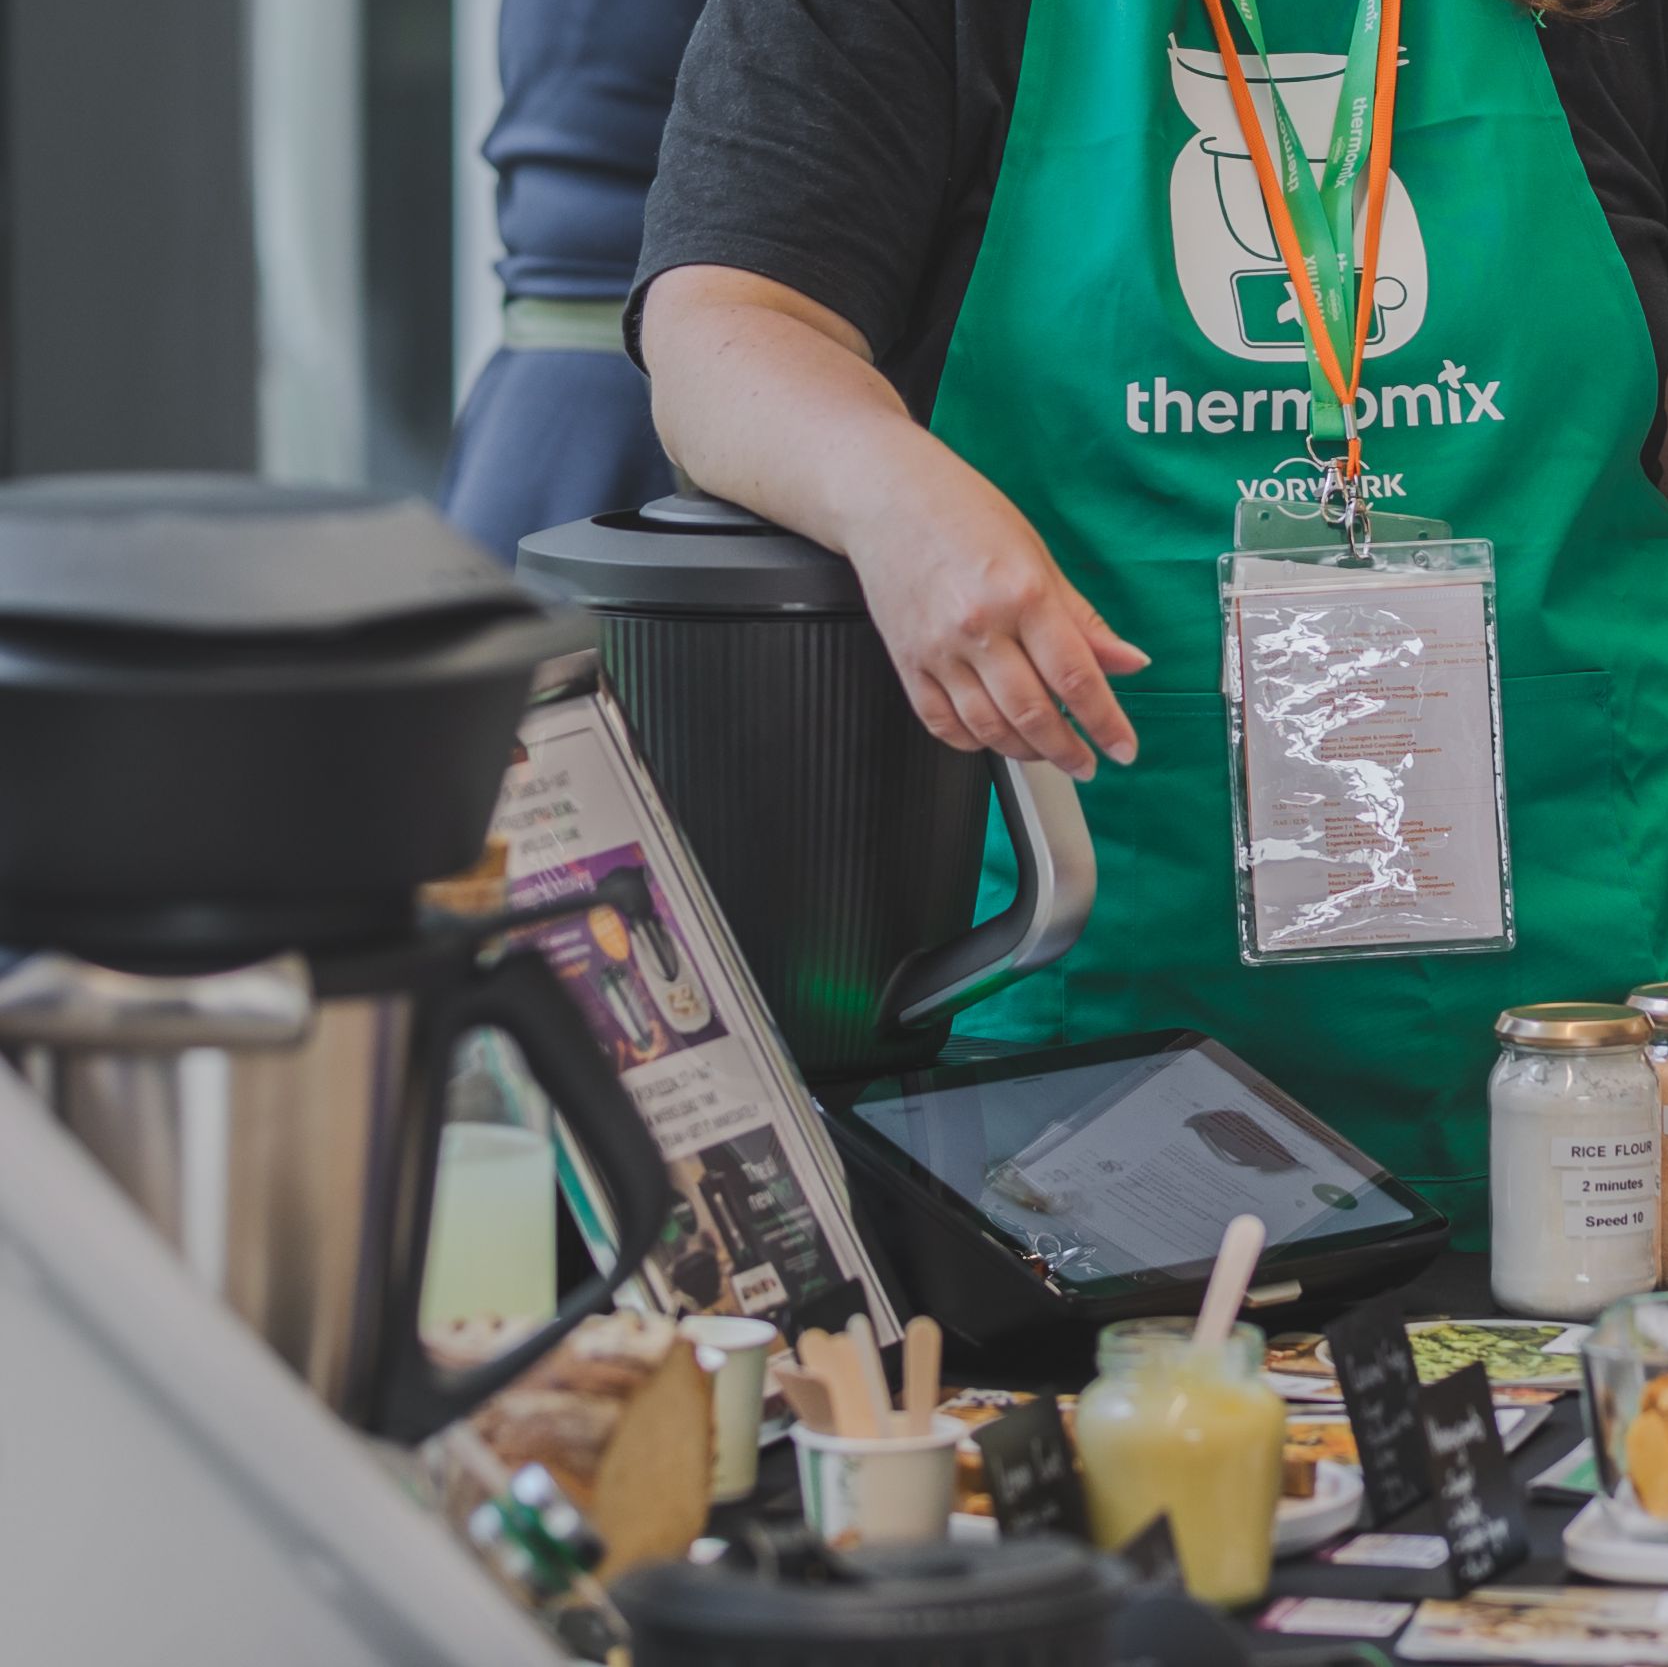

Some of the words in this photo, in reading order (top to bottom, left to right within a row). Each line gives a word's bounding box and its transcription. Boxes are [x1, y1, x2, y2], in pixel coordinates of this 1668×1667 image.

[1335, 94, 1368, 189] thermomix
[1236, 473, 1407, 502] VORWRK
[1571, 1145, 1606, 1158] RICE
[1615, 1140, 1653, 1157] FLOUR
[1582, 1180, 1590, 1192] 2
[1595, 1177, 1644, 1192] minutes
[1585, 1214, 1628, 1229] Speed
[1633, 1211, 1644, 1224] 10
